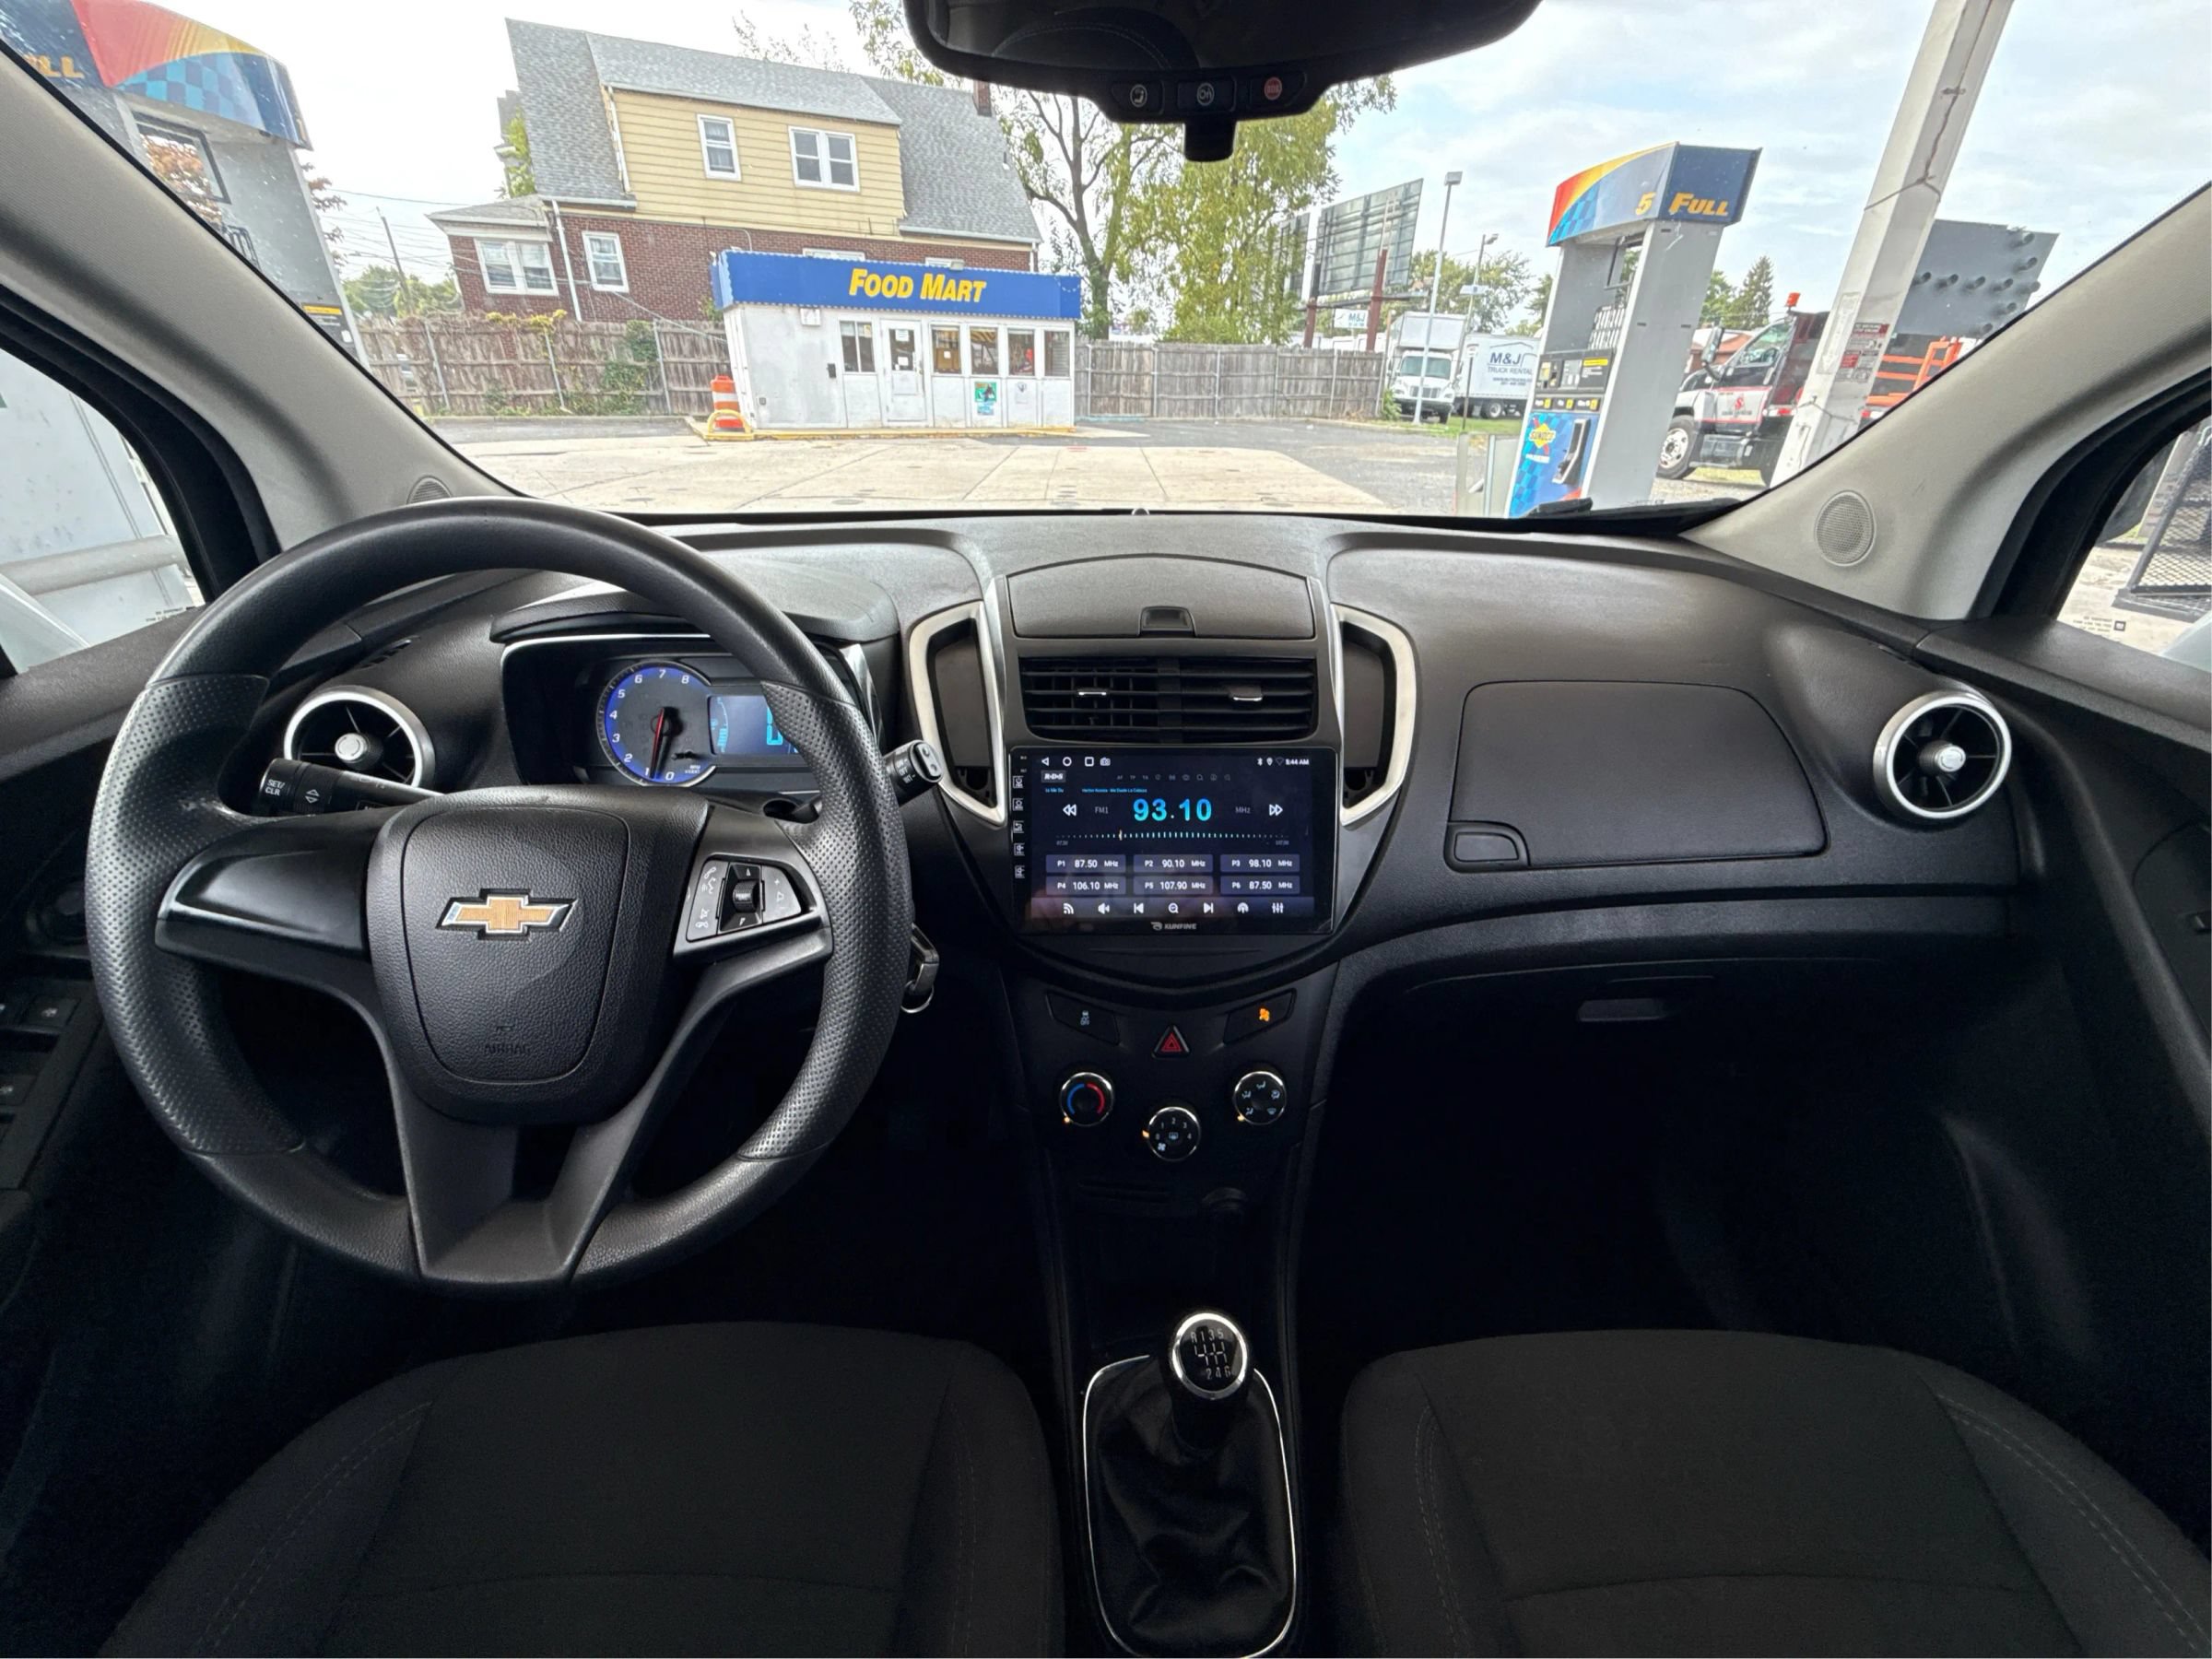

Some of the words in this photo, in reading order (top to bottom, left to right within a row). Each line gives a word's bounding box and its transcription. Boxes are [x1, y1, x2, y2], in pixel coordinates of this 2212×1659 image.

[1635, 191, 1656, 216] 5
[1668, 192, 1729, 217] FULL
[849, 268, 914, 299] FOOD
[920, 273, 987, 303] MART
[1489, 351, 1522, 365] M&J
[659, 669, 666, 678] 7
[634, 674, 642, 684] 6
[681, 675, 689, 684] 8
[618, 689, 626, 698] 5
[609, 710, 618, 720] 4
[612, 734, 620, 743] 3
[623, 754, 633, 763] 2
[665, 771, 674, 781] 0
[1133, 798, 1212, 821] 93.10
[1074, 859, 1098, 868] 87.50
[1161, 859, 1185, 868] 90.10
[1248, 859, 1272, 868] 98.10
[1073, 881, 1100, 890] 106.10
[1159, 881, 1187, 890] 107.90
[1249, 881, 1272, 890] 87.50
[1190, 1331, 1198, 1343] R
[1200, 1331, 1206, 1342] 1
[1207, 1329, 1216, 1341] 3
[1218, 1328, 1224, 1339] 5
[1206, 1368, 1213, 1380] 2
[1215, 1366, 1222, 1379] 4
